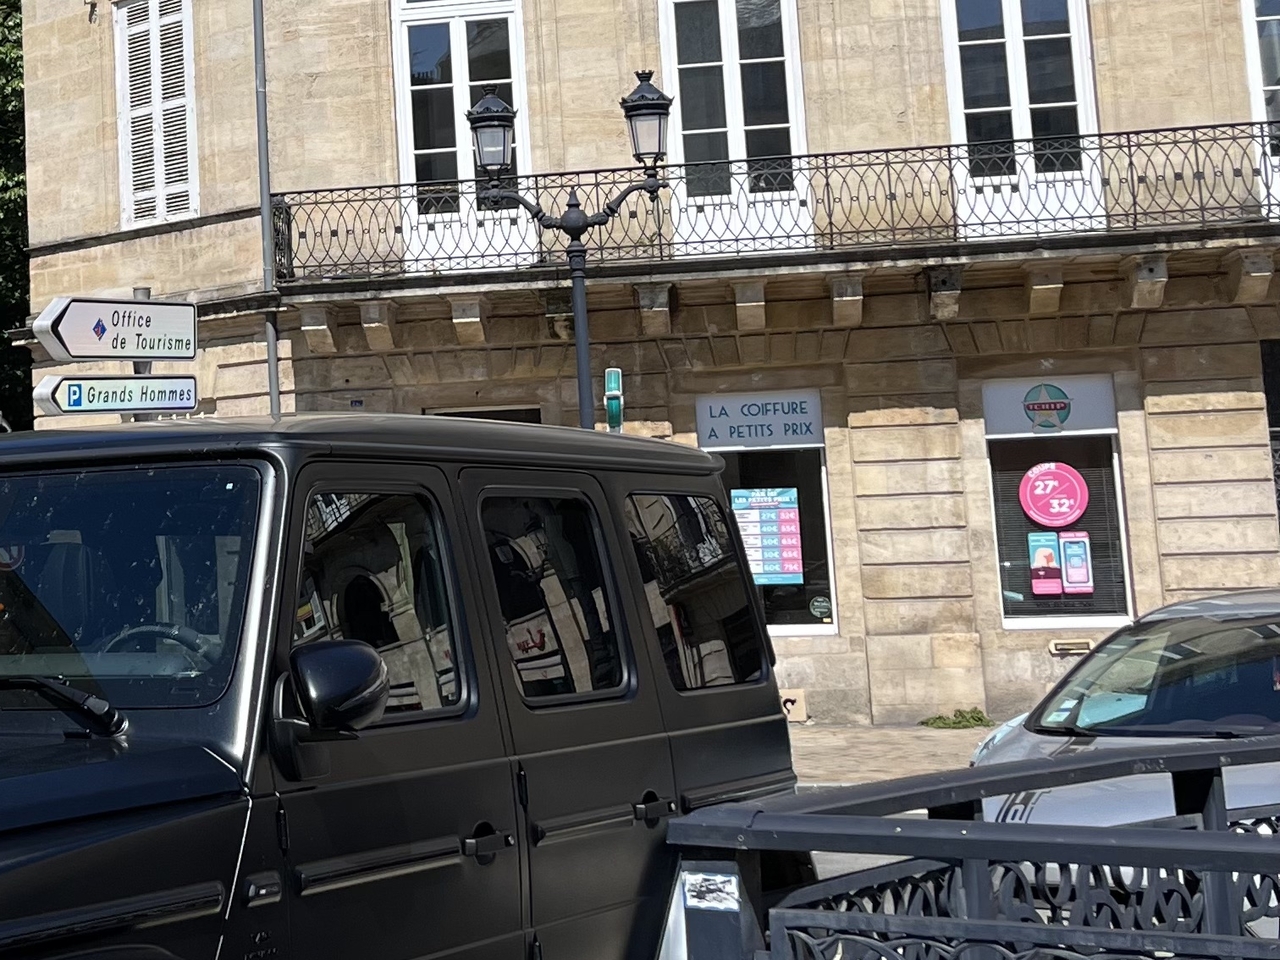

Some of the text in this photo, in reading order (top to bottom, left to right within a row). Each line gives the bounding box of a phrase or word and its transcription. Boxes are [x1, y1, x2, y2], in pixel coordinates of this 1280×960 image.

[111, 310, 151, 328] Office
[111, 333, 191, 351] de Tourisme
[87, 385, 133, 404] Grands
[140, 385, 192, 402] Hommes
[709, 400, 808, 418] LA COIFFURE
[1028, 402, 1065, 410] TCHIP
[707, 421, 814, 440] A PETITS PRIX
[1027, 462, 1056, 478] COUPE
